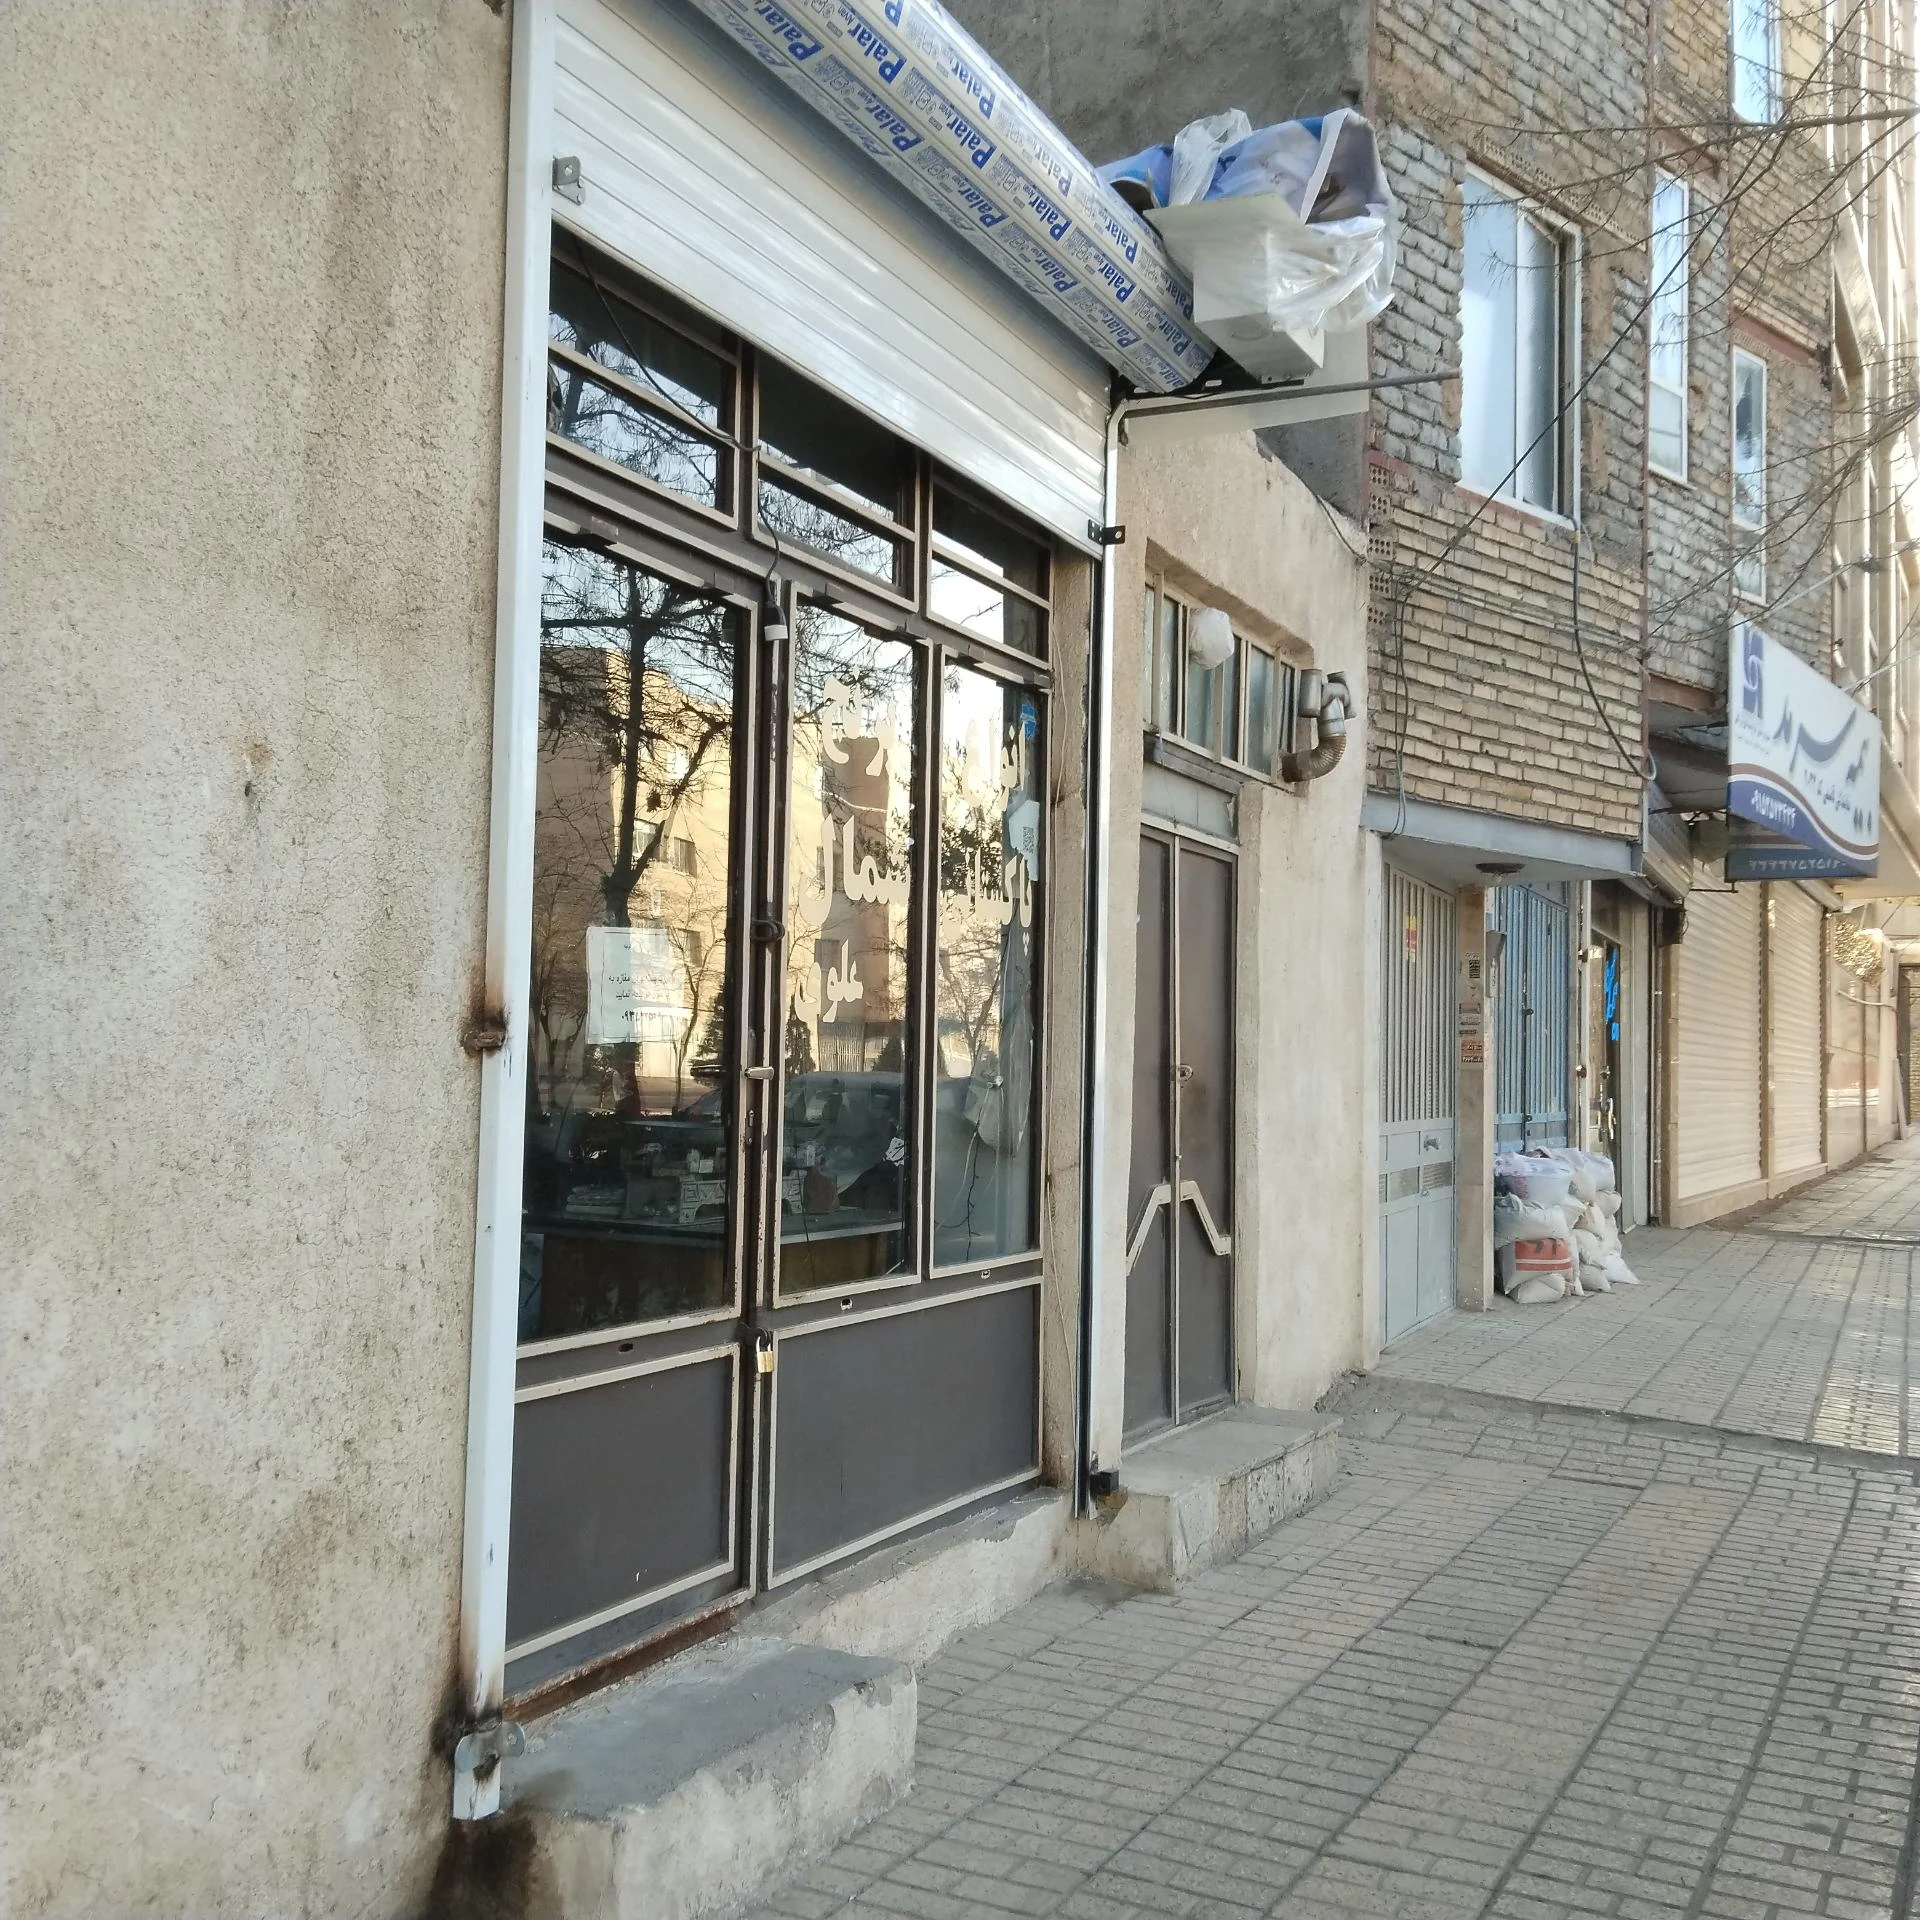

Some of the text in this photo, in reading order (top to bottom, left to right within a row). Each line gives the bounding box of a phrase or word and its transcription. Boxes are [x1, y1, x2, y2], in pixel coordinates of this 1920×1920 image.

[754, 4, 824, 60] Palar
[838, 6, 855, 25] Arvan
[847, 23, 907, 84] Palar
[951, 62, 995, 119] Palar
[865, 104, 925, 152] Palar
[946, 117, 997, 169] Palar
[1035, 147, 1074, 197] Palar
[958, 187, 1009, 228] Palar
[1028, 196, 1072, 241] Palar
[1105, 221, 1139, 264] Palar
[1035, 258, 1080, 292] Palar
[1098, 262, 1136, 303] Palar
[1102, 318, 1142, 348] Palar
[1158, 320, 1192, 356] Palar
[1160, 367, 1185, 387] alar
[821, 665, 897, 777] برنج
[799, 812, 1032, 956] پاکستانی شمال
[795, 938, 864, 1023] علوی
